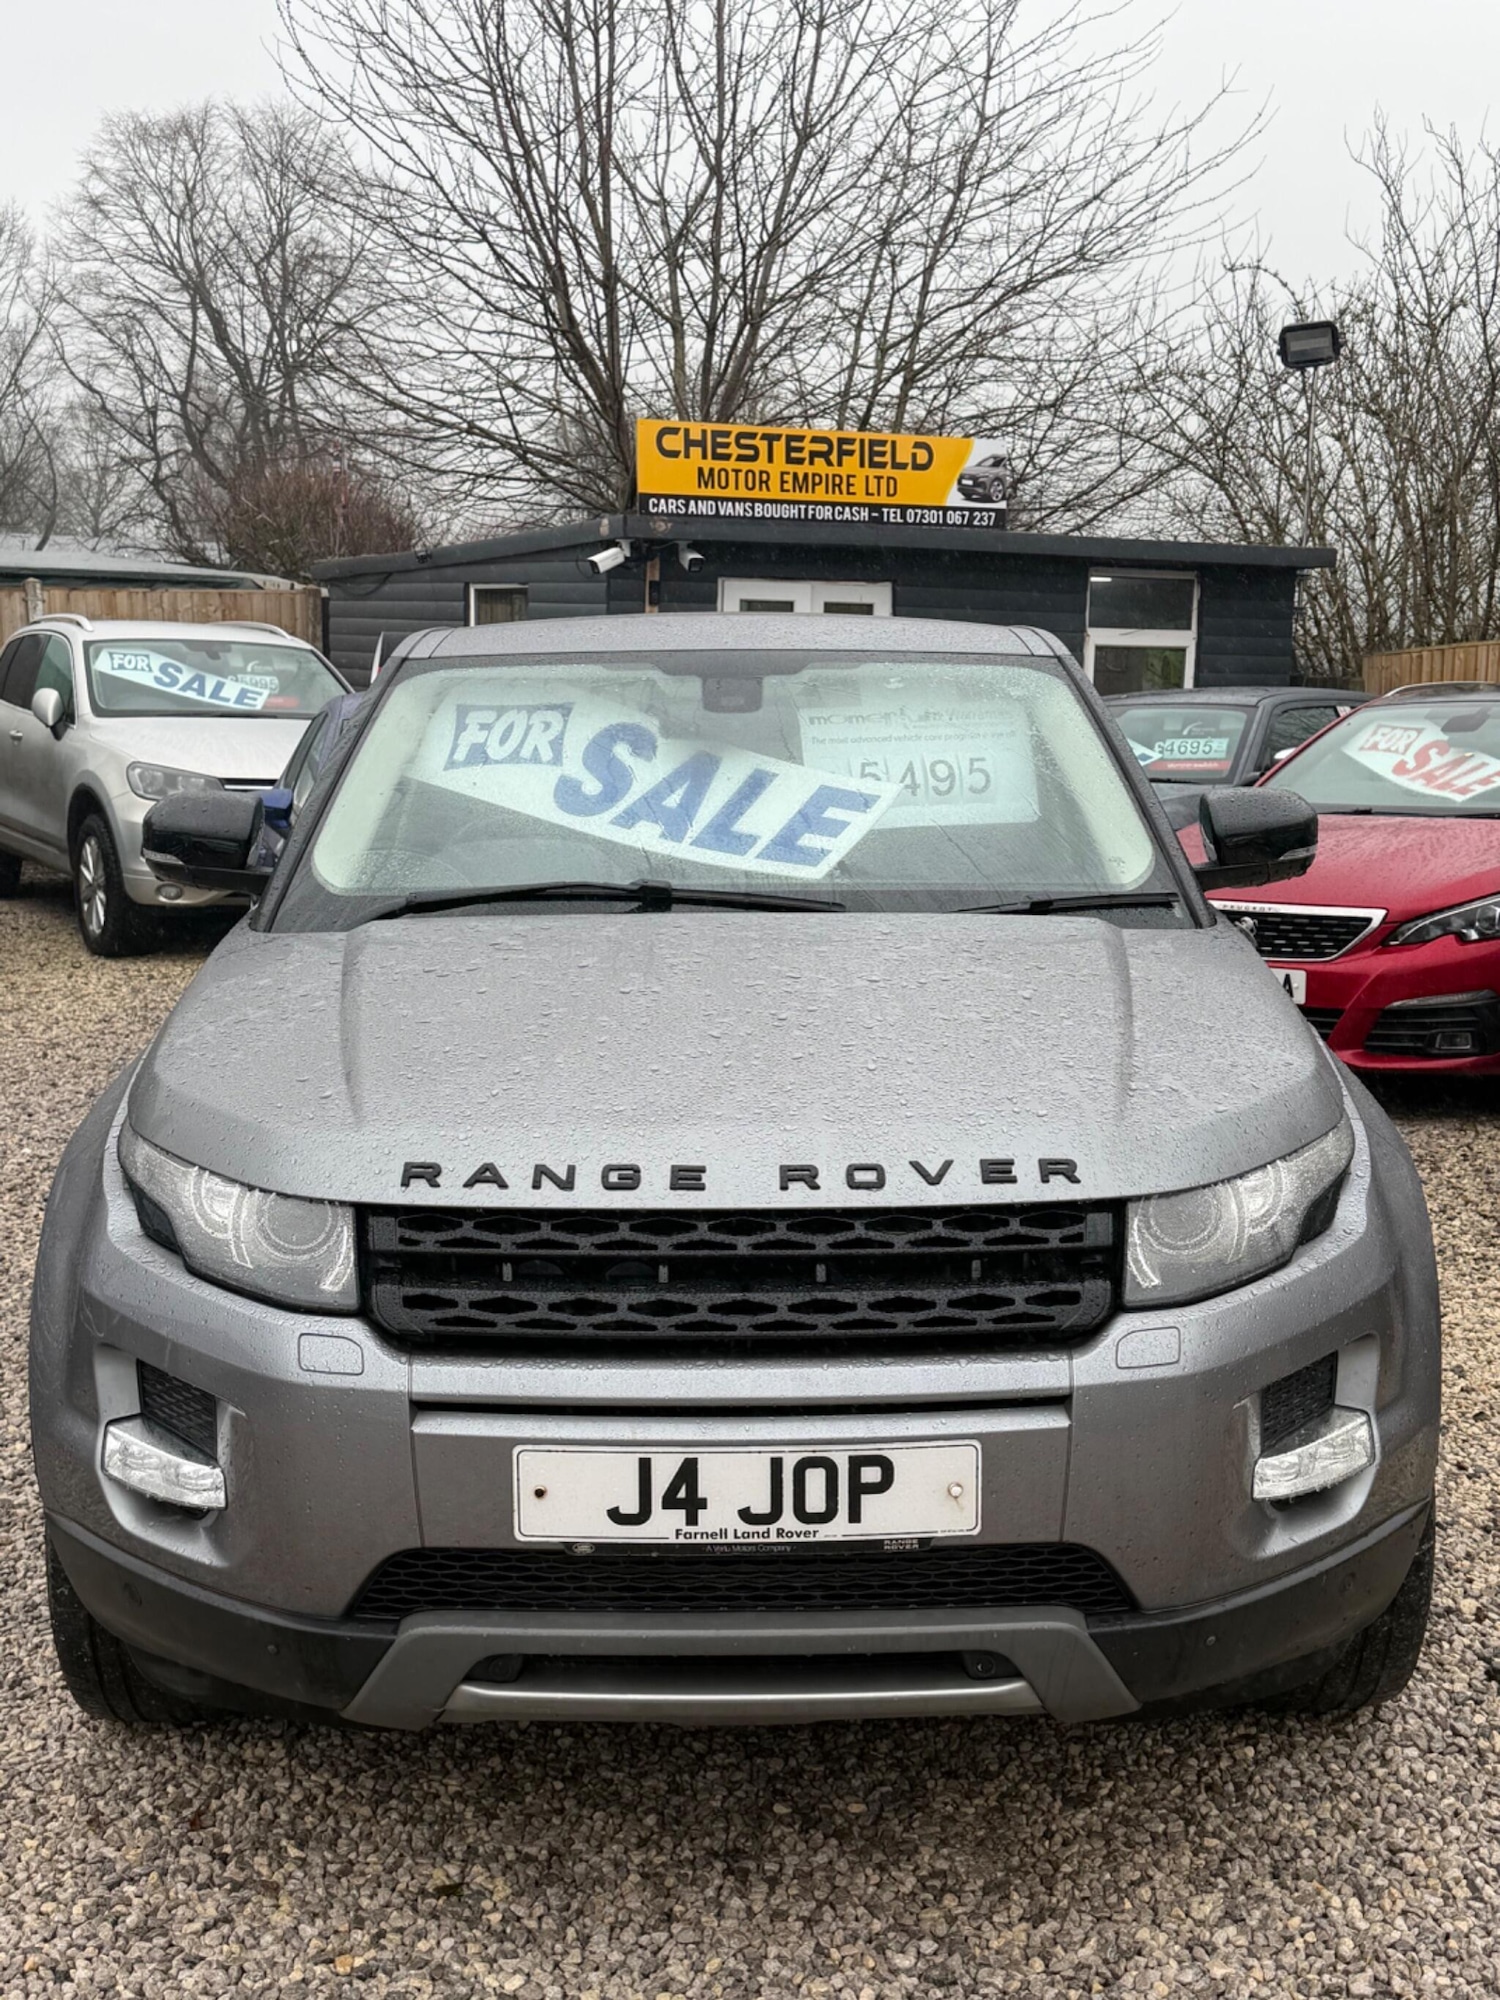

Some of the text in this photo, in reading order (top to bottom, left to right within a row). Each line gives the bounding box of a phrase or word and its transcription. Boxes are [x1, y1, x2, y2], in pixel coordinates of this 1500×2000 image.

[656, 426, 934, 472] CHESTERFIELD
[696, 466, 899, 498] MOTOR EMPIRE LTD
[649, 497, 687, 515] CARS
[688, 499, 716, 516] AND
[717, 501, 753, 518] VANS
[754, 502, 807, 520] BOUGHT
[808, 505, 833, 521] FOR
[834, 506, 869, 522] CASH
[882, 508, 904, 523] TEL
[906, 509, 944, 525] 07301
[946, 511, 969, 526] 067
[973, 512, 996, 526] 237
[113, 653, 264, 708] FOR SALE
[1363, 726, 1500, 796] FOR SALE
[451, 706, 880, 867] FOR SALE
[399, 1157, 1082, 1191] RANGE ROVER
[606, 1454, 896, 1527] J4 JOP
[674, 1526, 820, 1541] Farnell Land Rover
